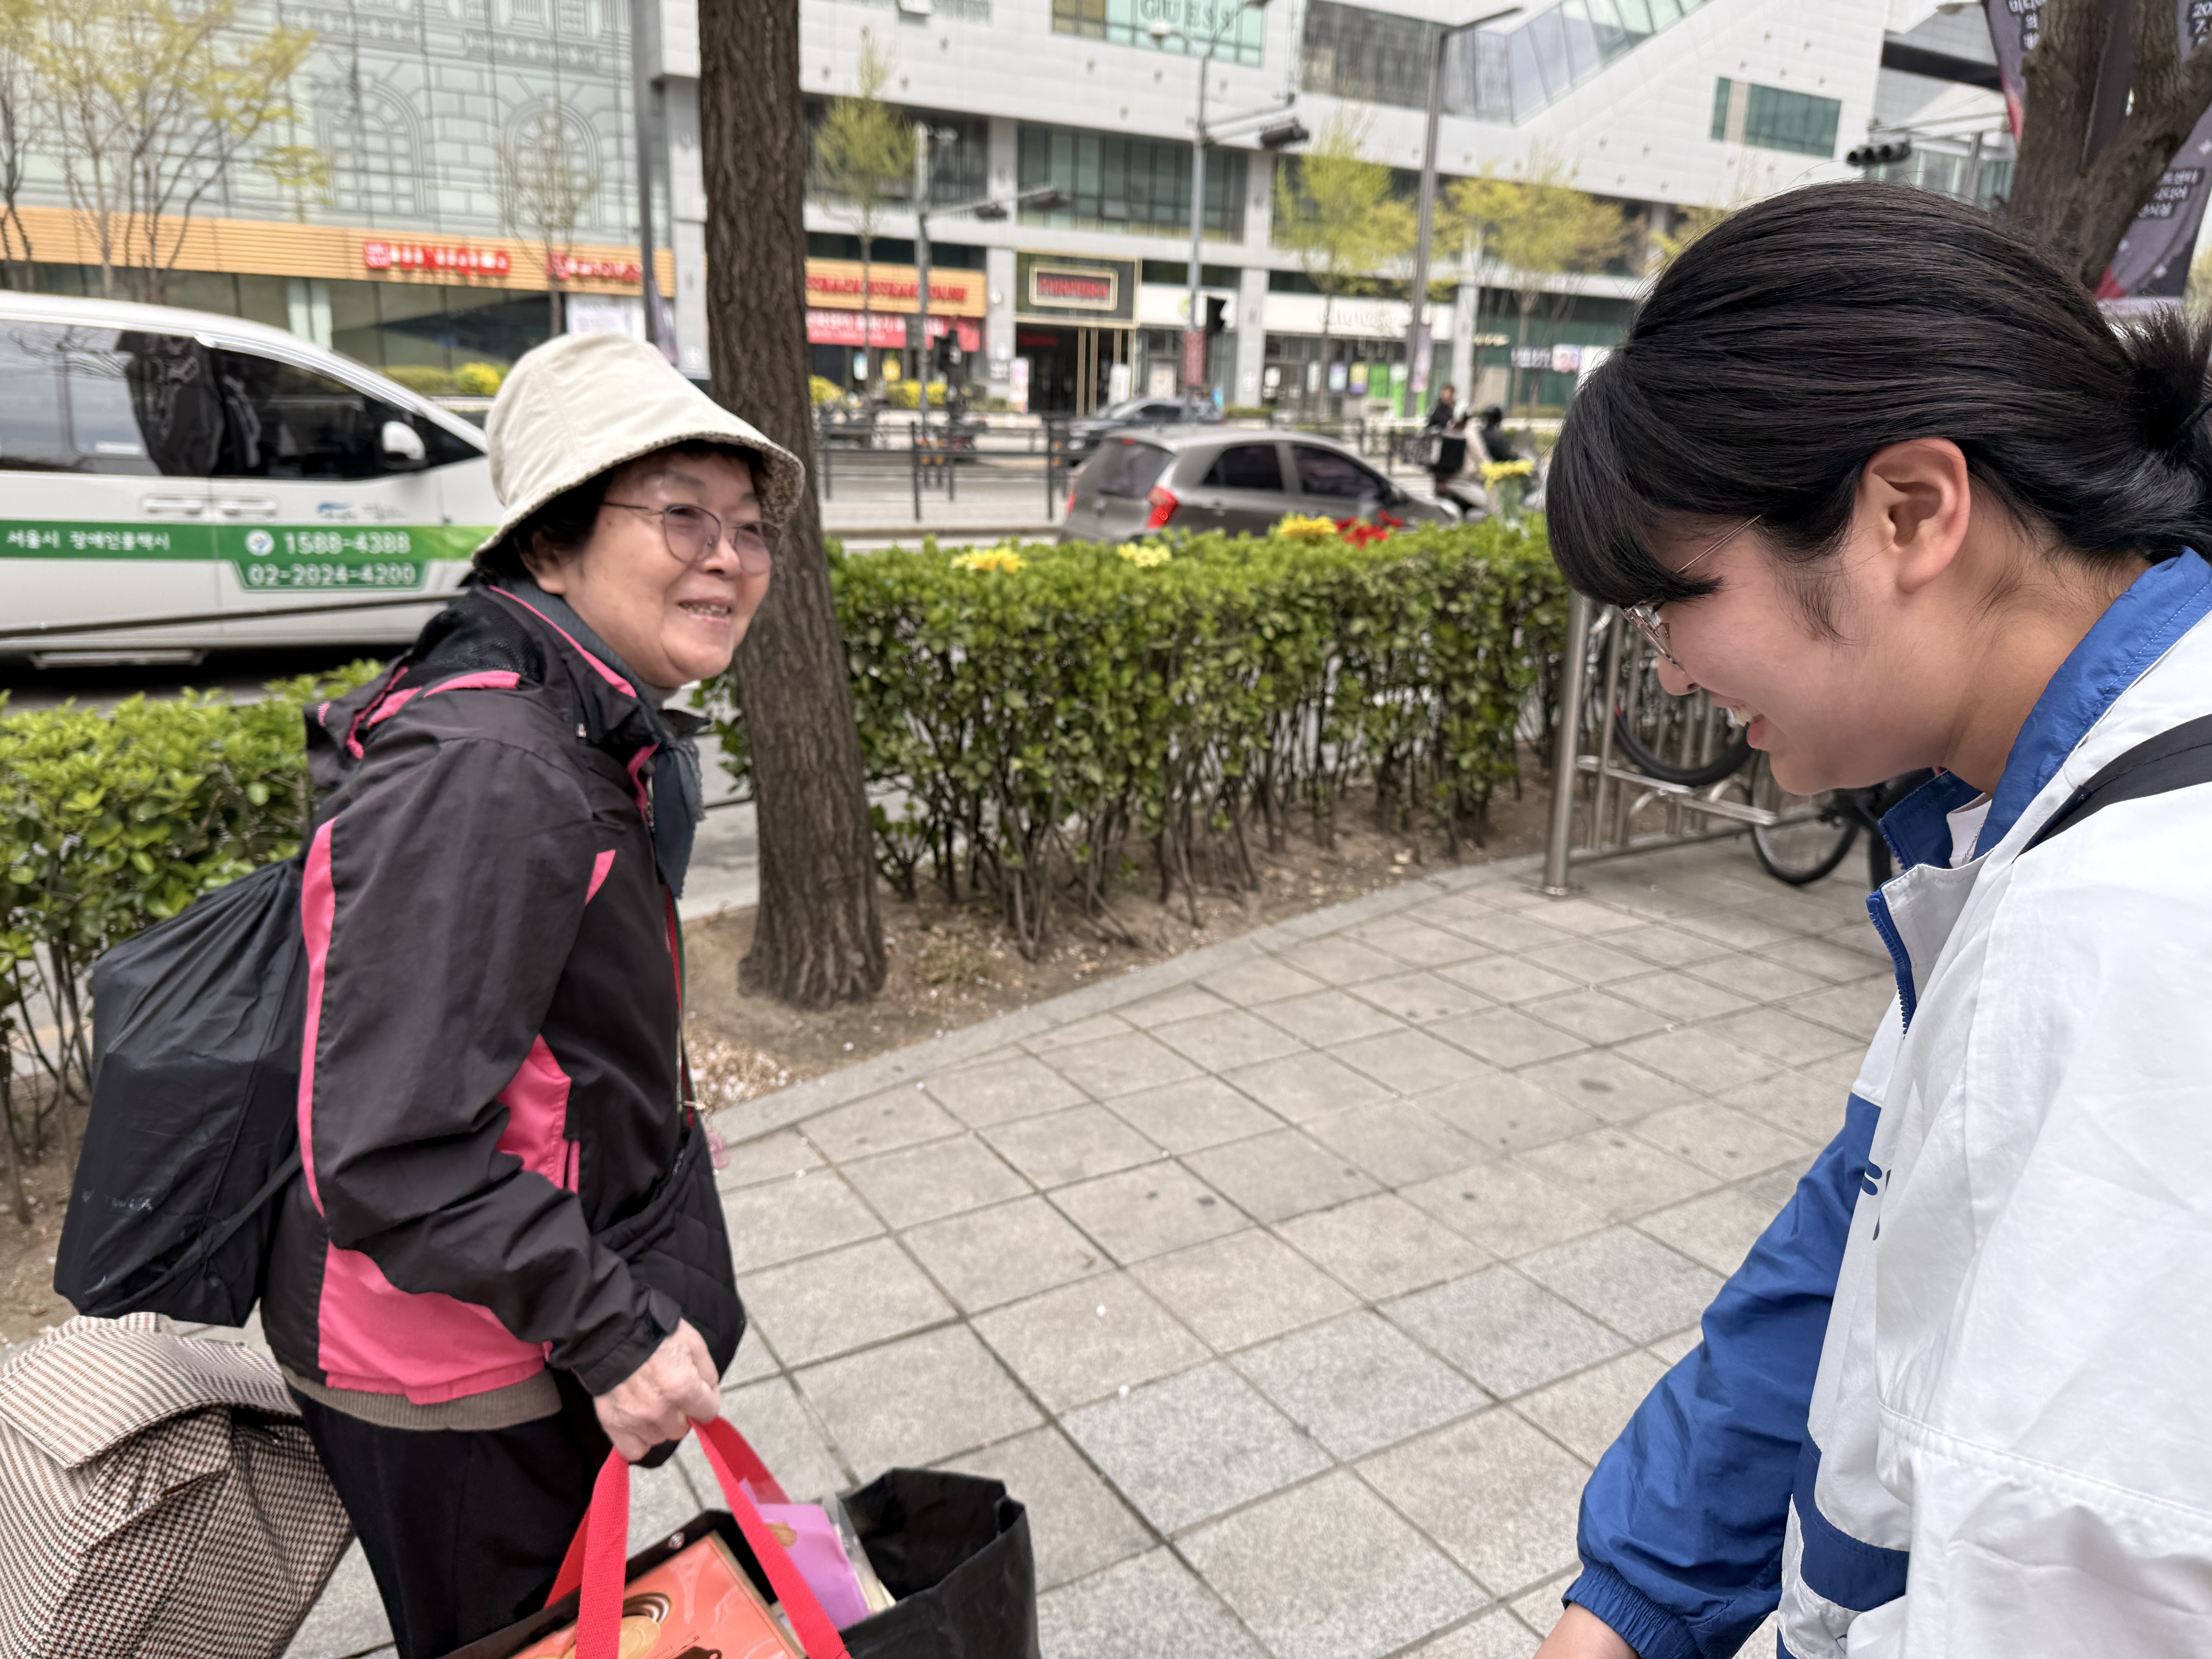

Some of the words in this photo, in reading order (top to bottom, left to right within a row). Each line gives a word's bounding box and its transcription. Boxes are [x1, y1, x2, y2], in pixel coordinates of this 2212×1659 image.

[7, 529, 60, 549] 서울시
[69, 531, 171, 551] 장애인콜택시
[283, 531, 411, 554] 1588-4388
[248, 563, 416, 585] 02-2024-4200
